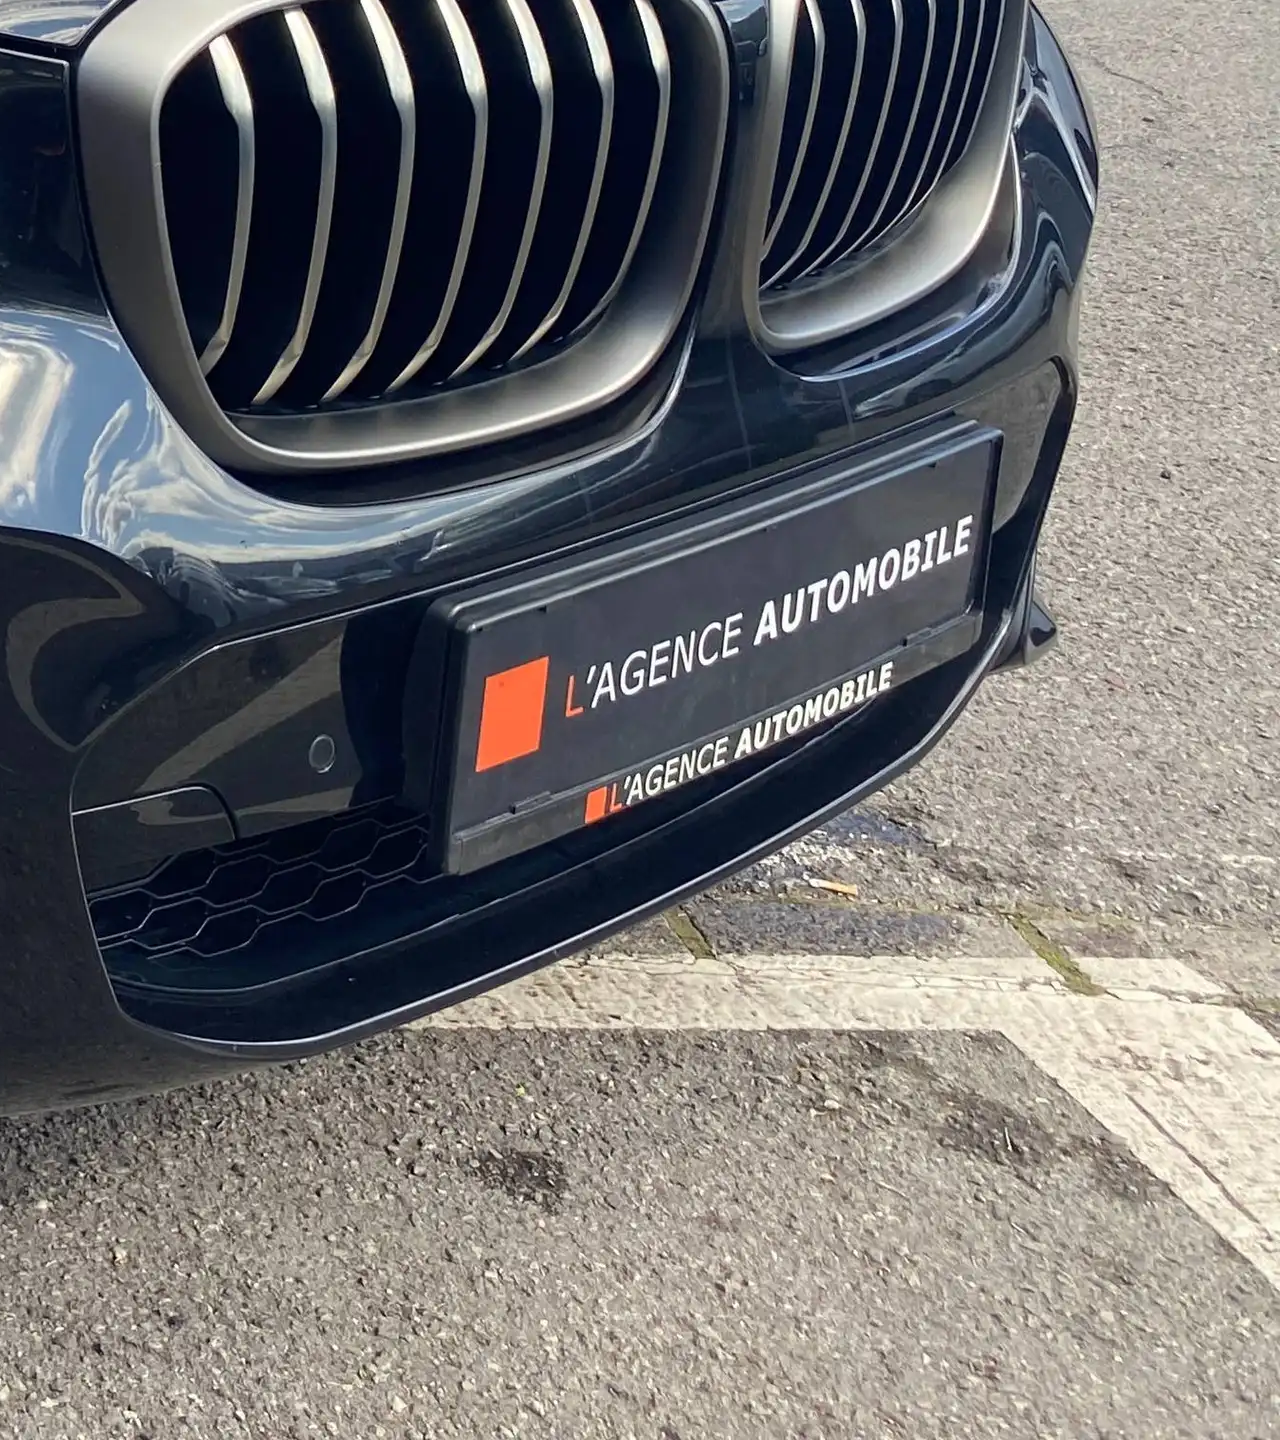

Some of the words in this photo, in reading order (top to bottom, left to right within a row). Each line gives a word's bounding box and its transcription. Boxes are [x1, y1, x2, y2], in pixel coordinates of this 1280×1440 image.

[565, 612, 743, 718] L'AGENCE
[753, 514, 975, 647] AUTOMOBILE
[608, 736, 730, 814] L'AGENCE
[734, 661, 895, 760] AUTOMOBILE
